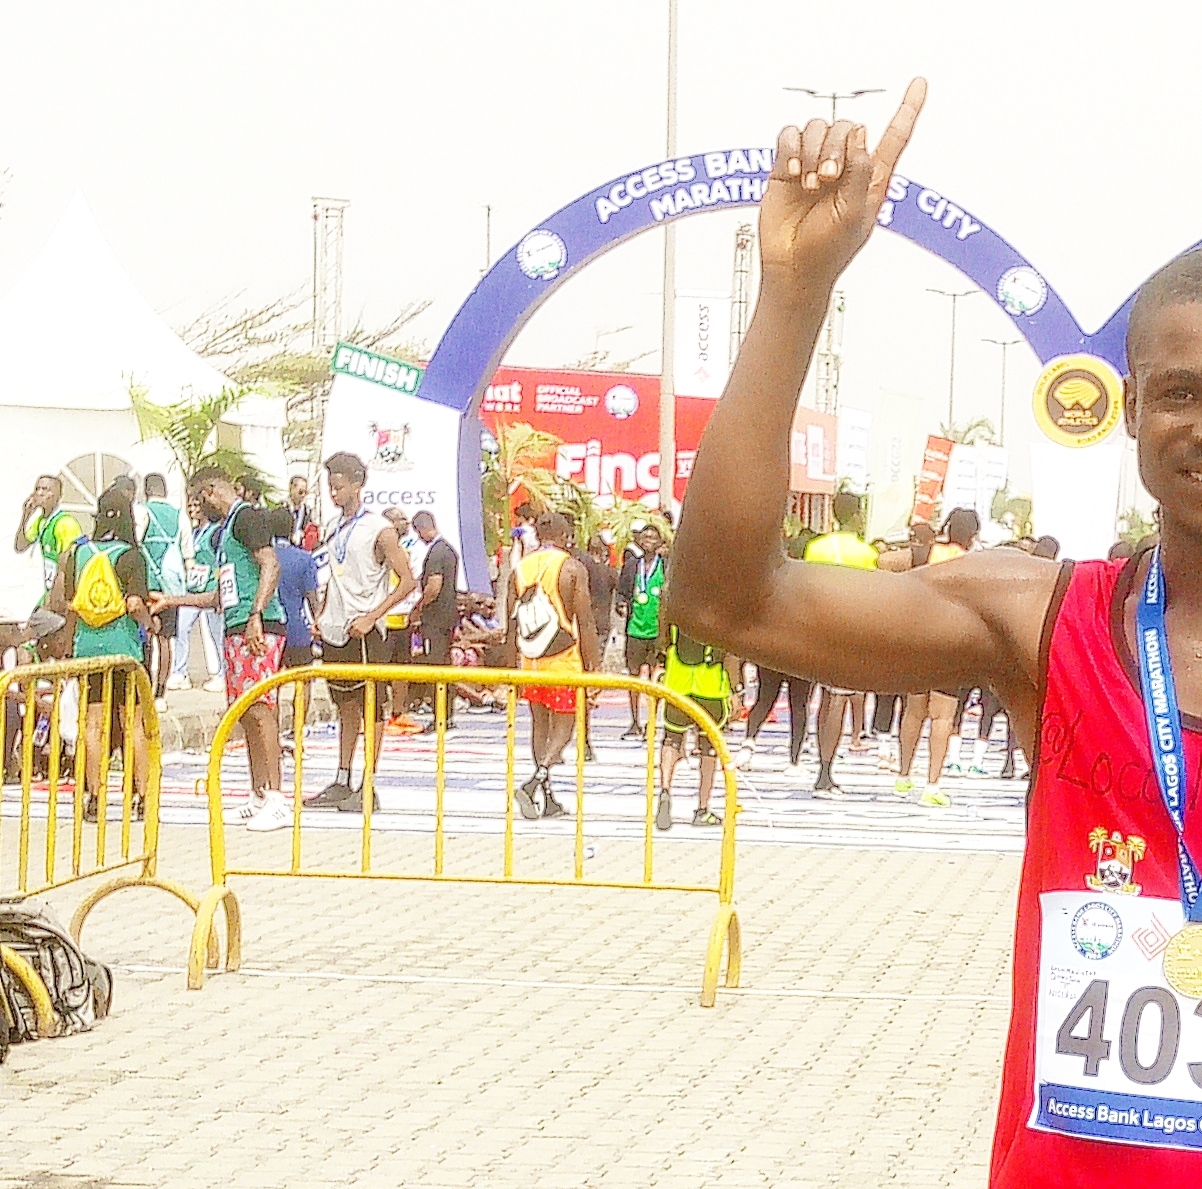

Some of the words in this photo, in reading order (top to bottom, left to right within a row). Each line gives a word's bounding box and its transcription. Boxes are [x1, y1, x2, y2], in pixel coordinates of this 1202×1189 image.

[595, 158, 697, 224] ACCESS
[704, 149, 777, 179] BAN
[917, 193, 982, 241] CITY
[649, 178, 769, 222] MARATH
[698, 303, 710, 361] access
[335, 347, 420, 392] FINISH
[535, 403, 584, 415] PARTNER
[536, 385, 581, 396] OFFICIAL
[536, 394, 600, 406] BROADCAST
[362, 490, 437, 505] access
[1144, 630, 1168, 714] MARATHON
[1157, 716, 1176, 751] CITY
[1162, 753, 1184, 807] LAGOS
[1048, 1098, 1095, 1121] Access
[1096, 1103, 1139, 1126] Bank
[1143, 1111, 1196, 1135] Lagos
